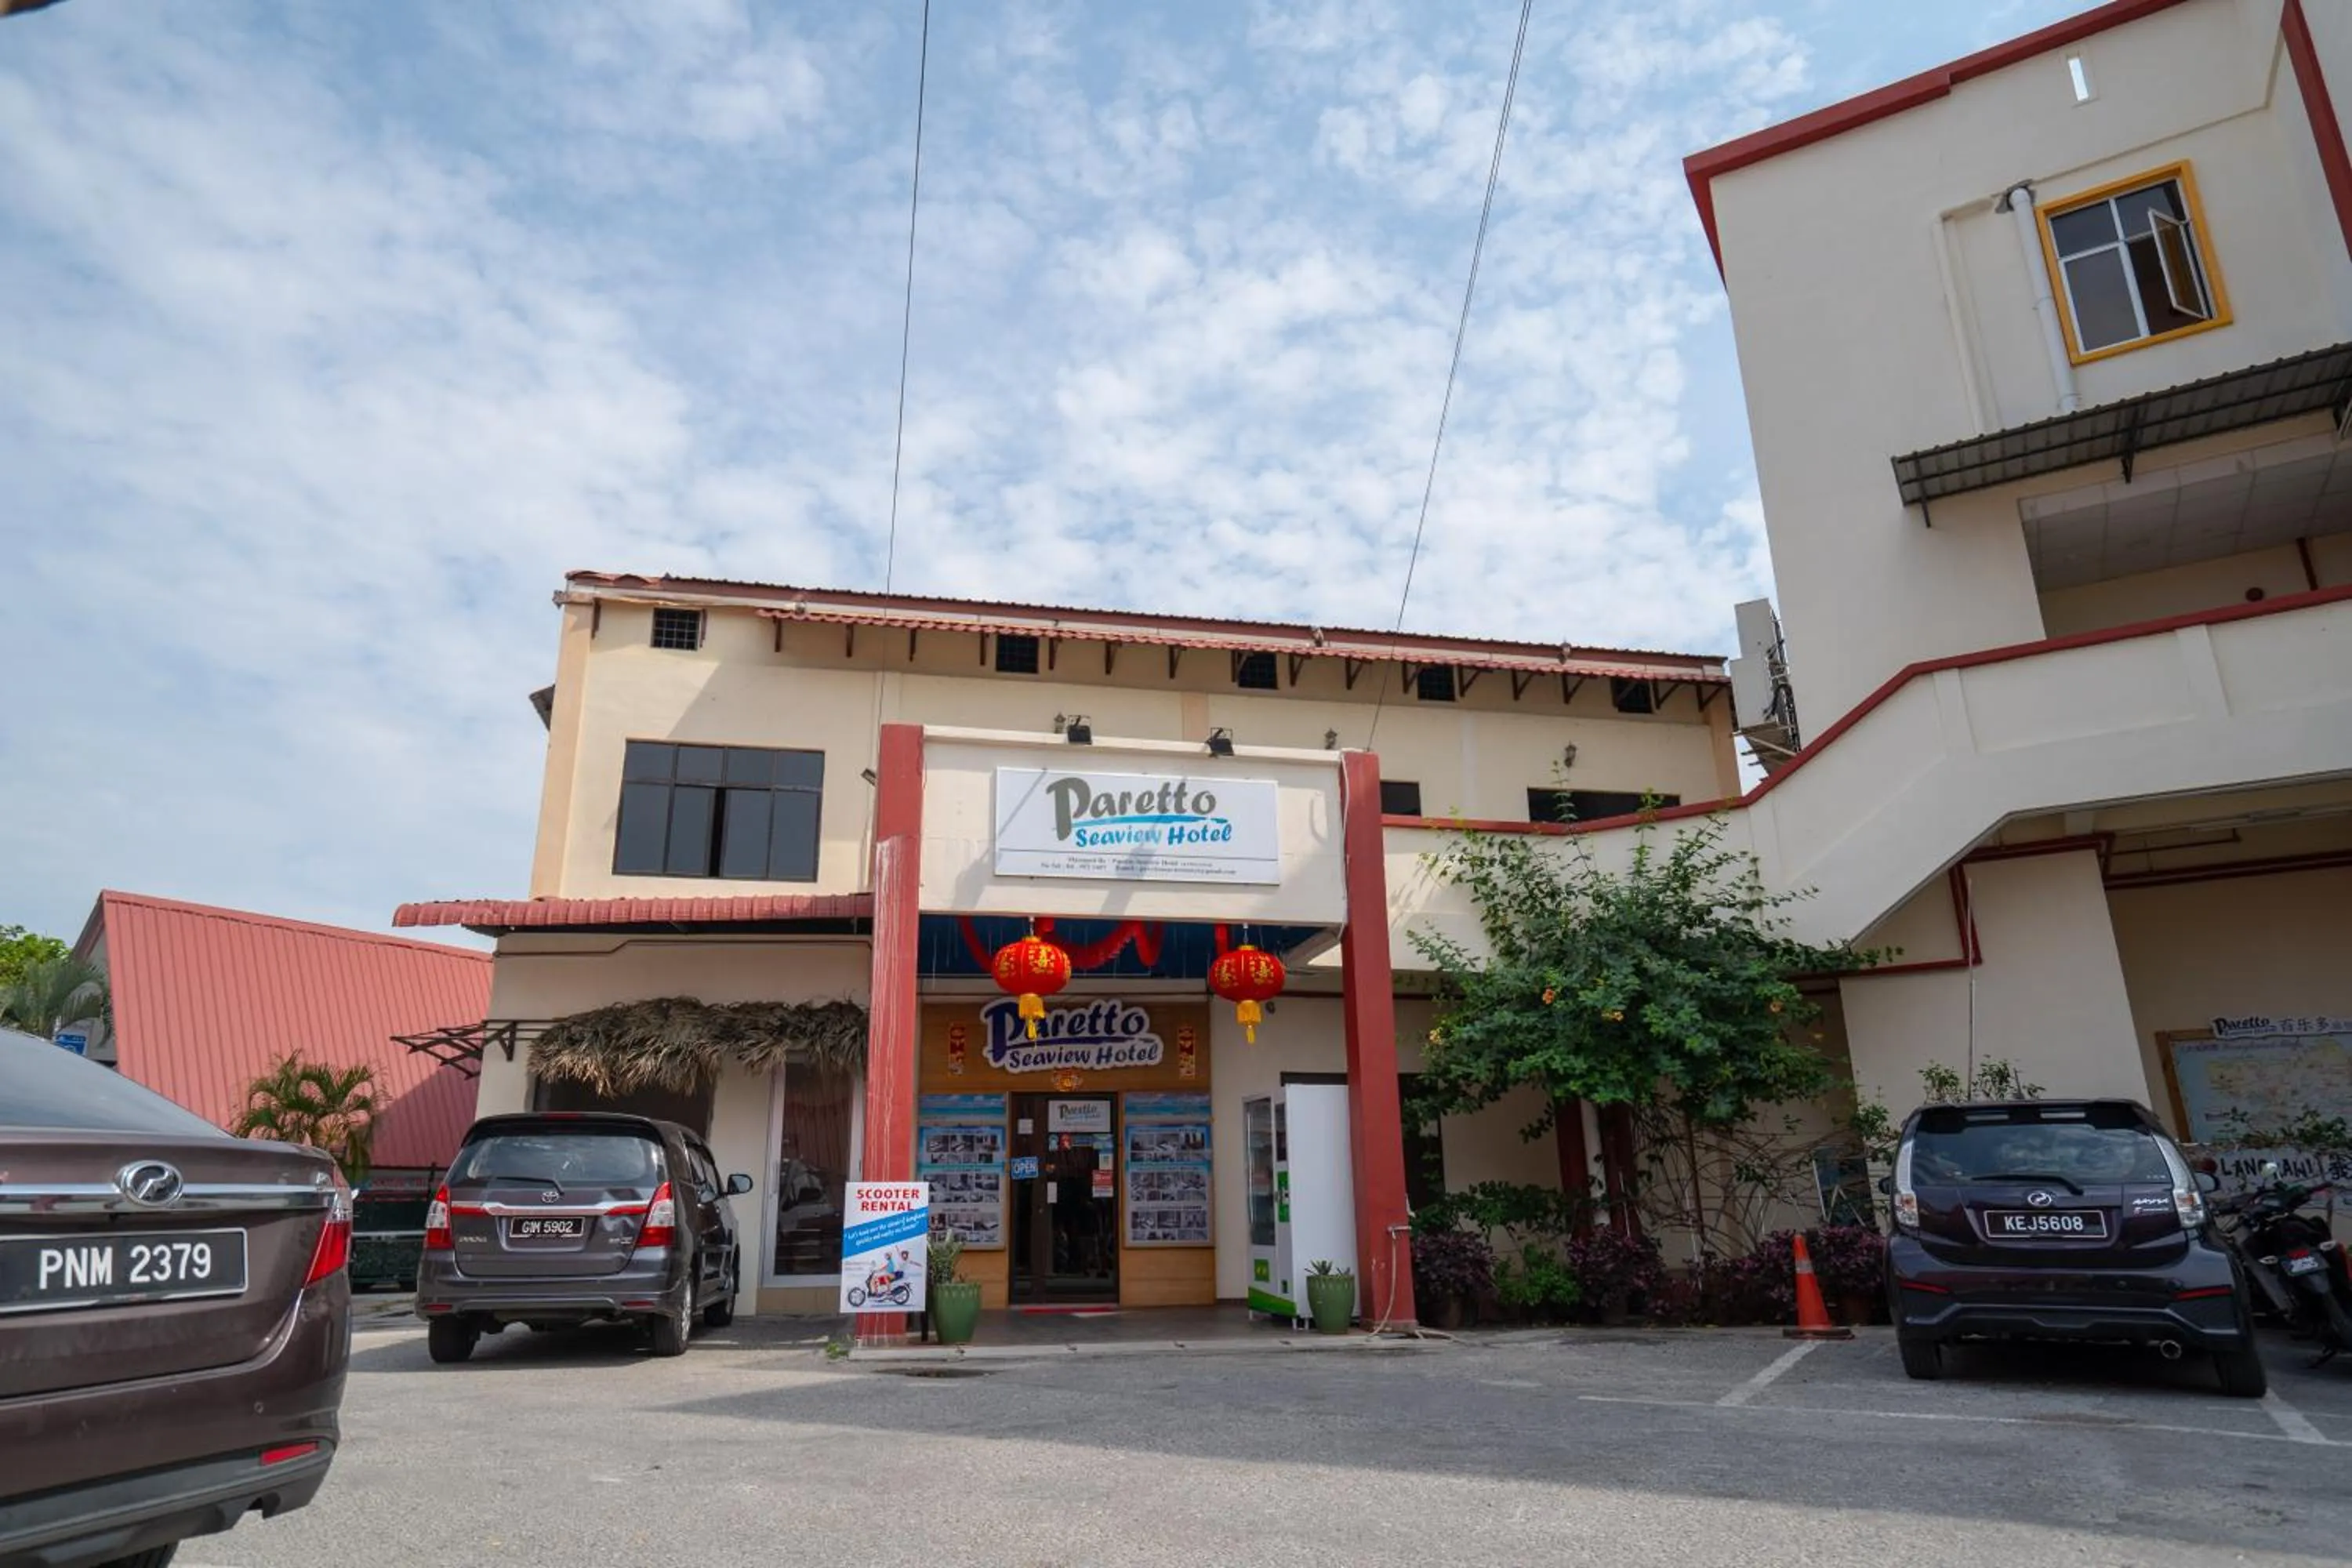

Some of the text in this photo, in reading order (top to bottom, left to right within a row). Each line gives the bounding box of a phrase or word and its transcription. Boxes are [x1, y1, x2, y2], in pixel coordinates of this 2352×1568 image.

[1046, 777, 1217, 841] Paretto
[1075, 823, 1232, 848] Seaview Hotel
[1008, 1044, 1158, 1069] Seaview Hotel
[1014, 1161, 1036, 1174] OPEN
[2220, 1156, 2314, 1178] LANAWI
[857, 1189, 920, 1199] SCOOTER
[861, 1201, 914, 1211] RENTAL
[543, 1220, 574, 1233] 5902
[2004, 1214, 2084, 1232] KEJ5608
[38, 1242, 212, 1290] PNM 2379
